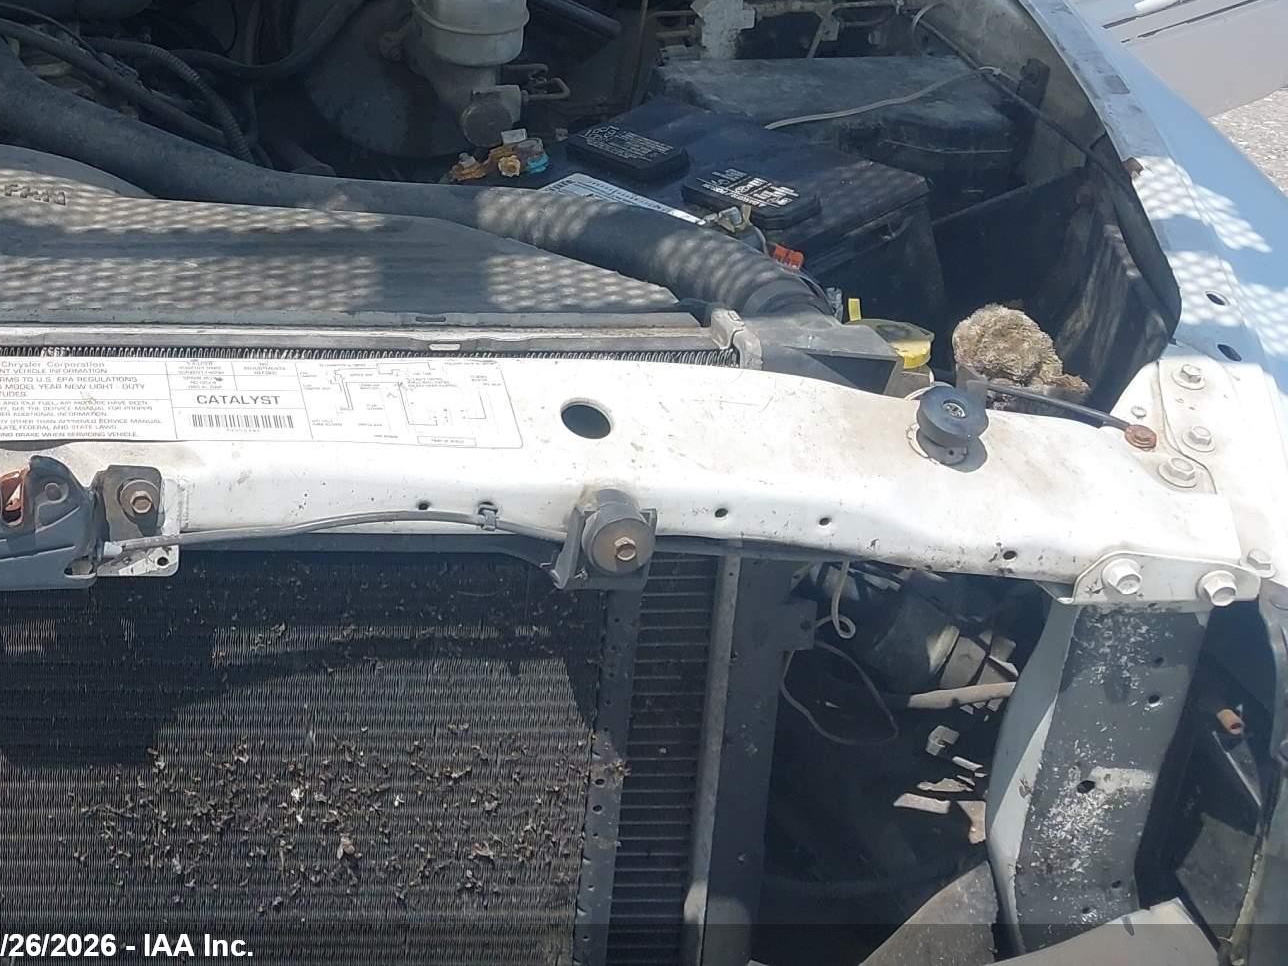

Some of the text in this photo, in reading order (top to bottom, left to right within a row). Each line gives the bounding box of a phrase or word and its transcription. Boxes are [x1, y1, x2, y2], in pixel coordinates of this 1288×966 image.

[4, 183, 66, 206] FAN
[46, 360, 105, 369] Corporation
[196, 394, 281, 405] CATALYST
